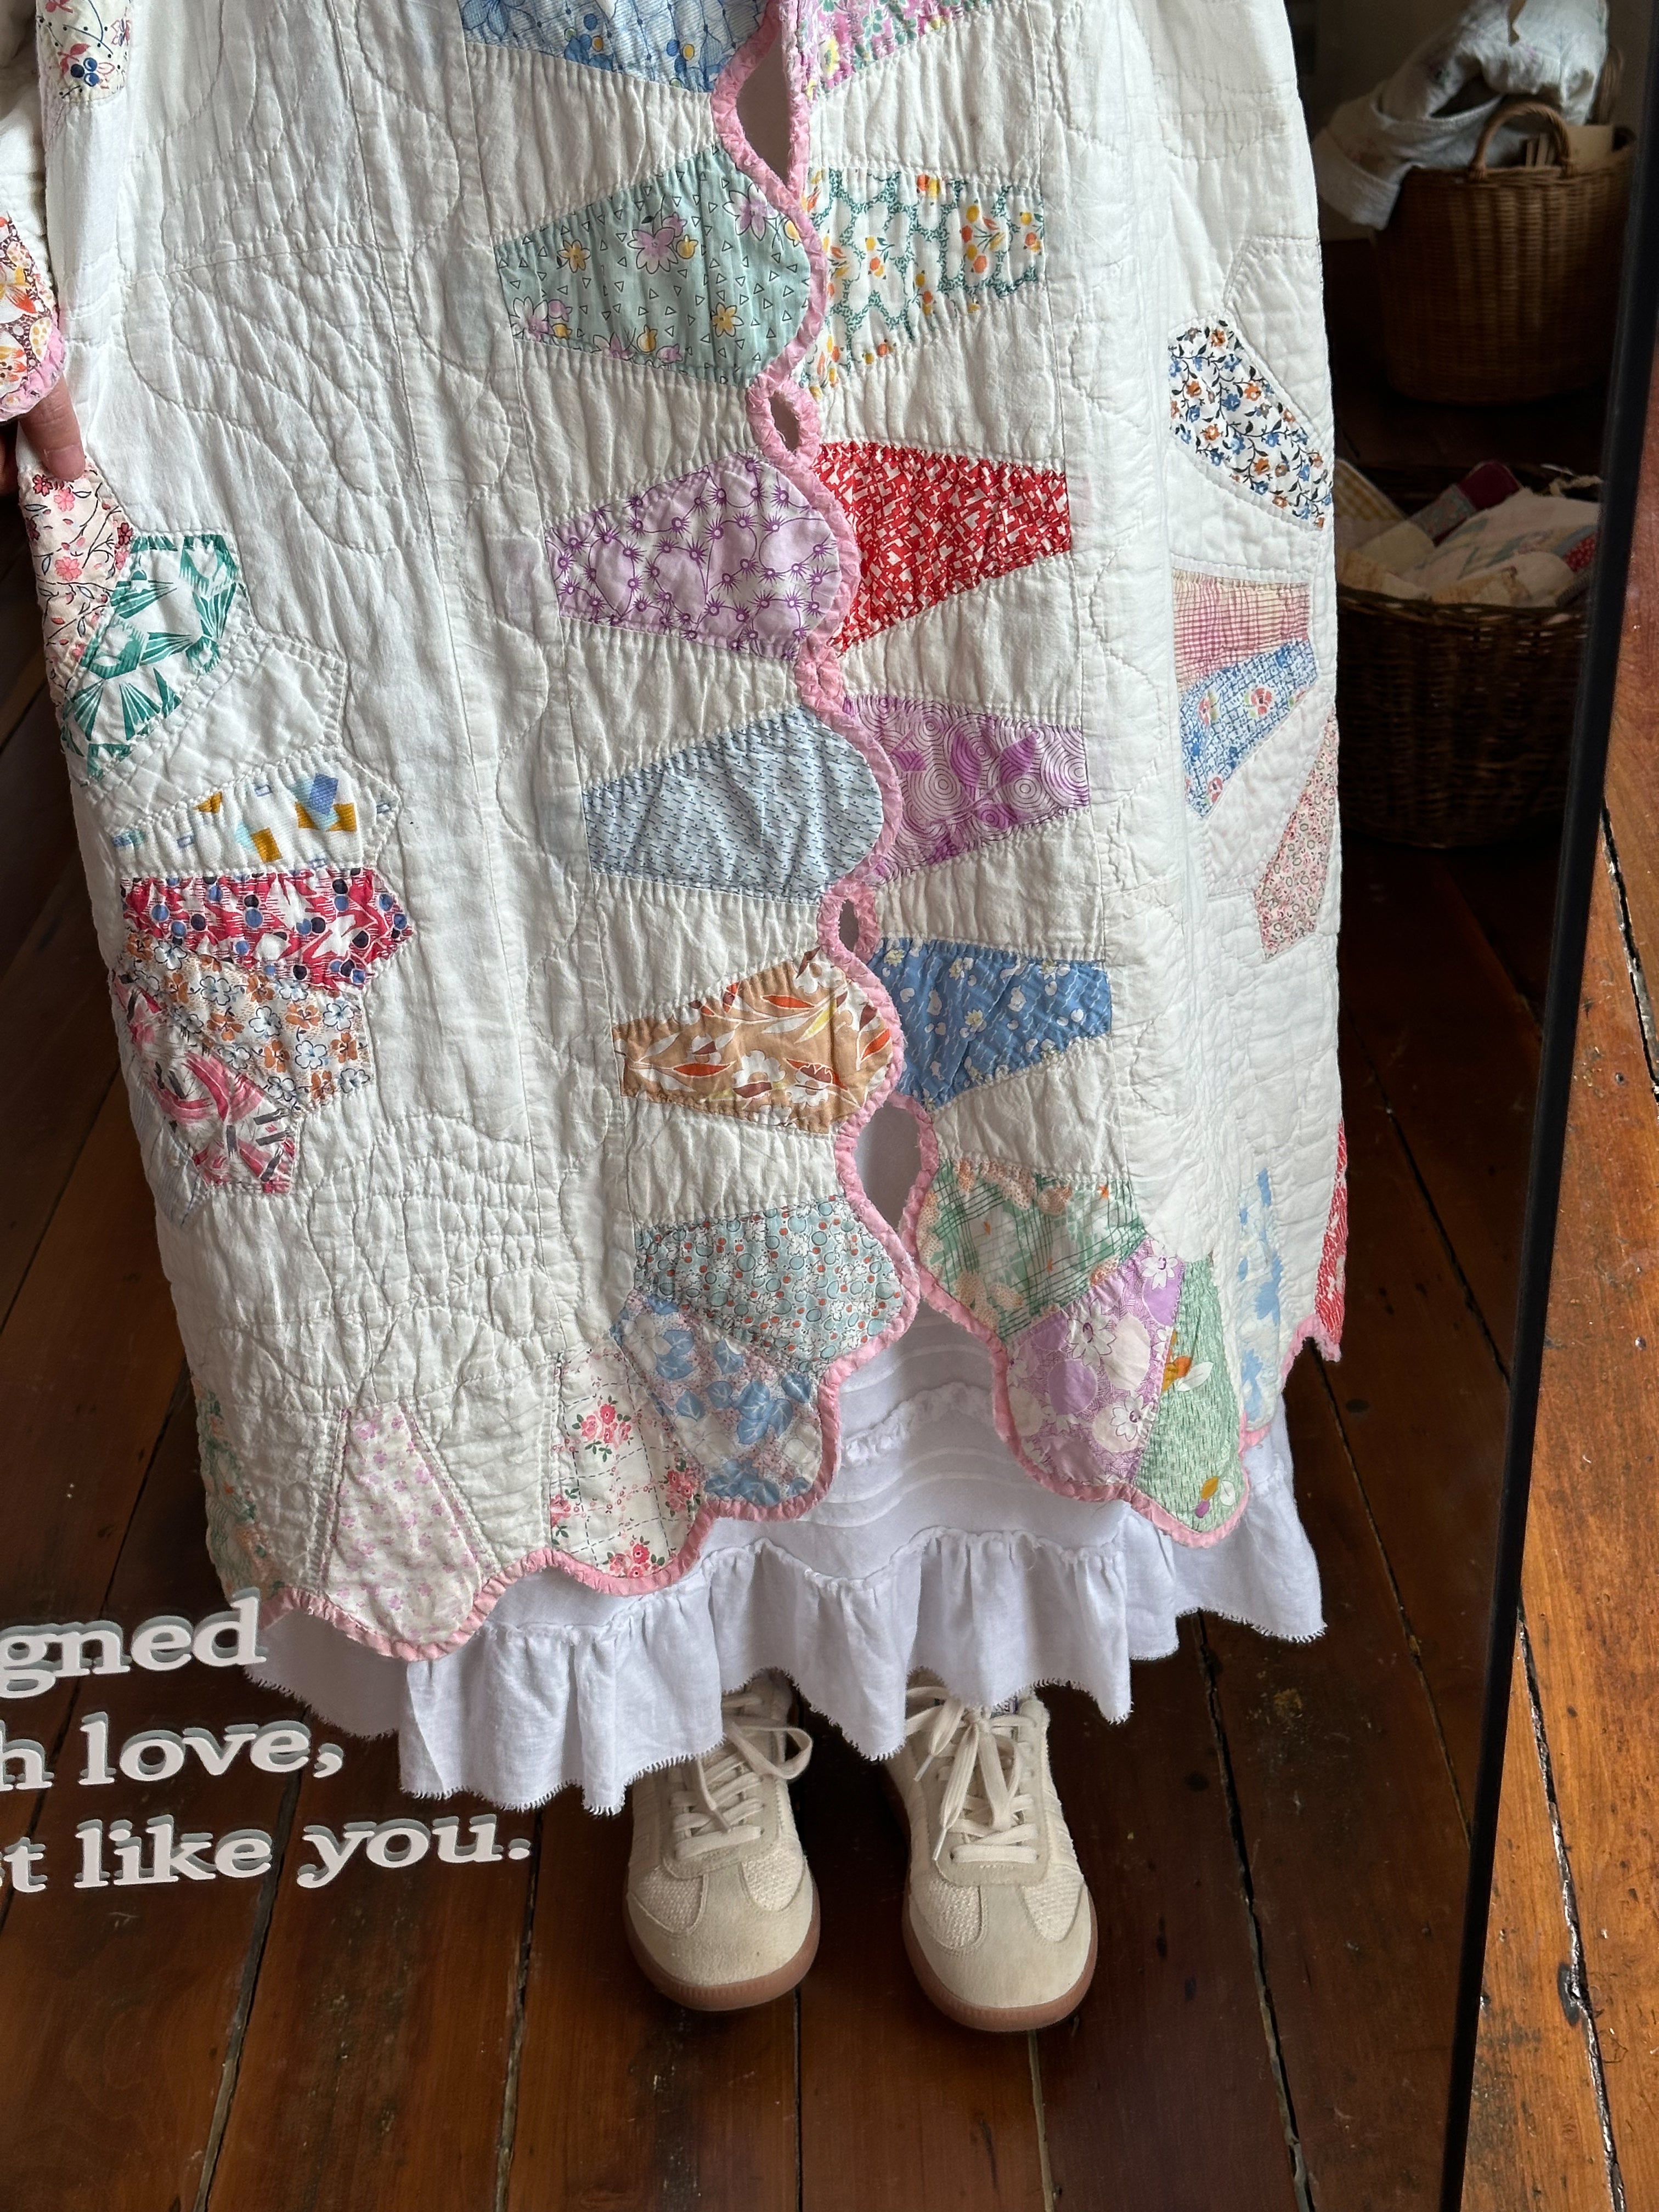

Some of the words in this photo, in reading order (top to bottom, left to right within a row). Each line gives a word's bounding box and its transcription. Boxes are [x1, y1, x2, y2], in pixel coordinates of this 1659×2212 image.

[0, 1596, 266, 1699] gned
[79, 1717, 344, 1786] love,
[0, 1844, 46, 1893] t
[74, 1819, 273, 1888] like
[297, 1821, 531, 1888] you.
